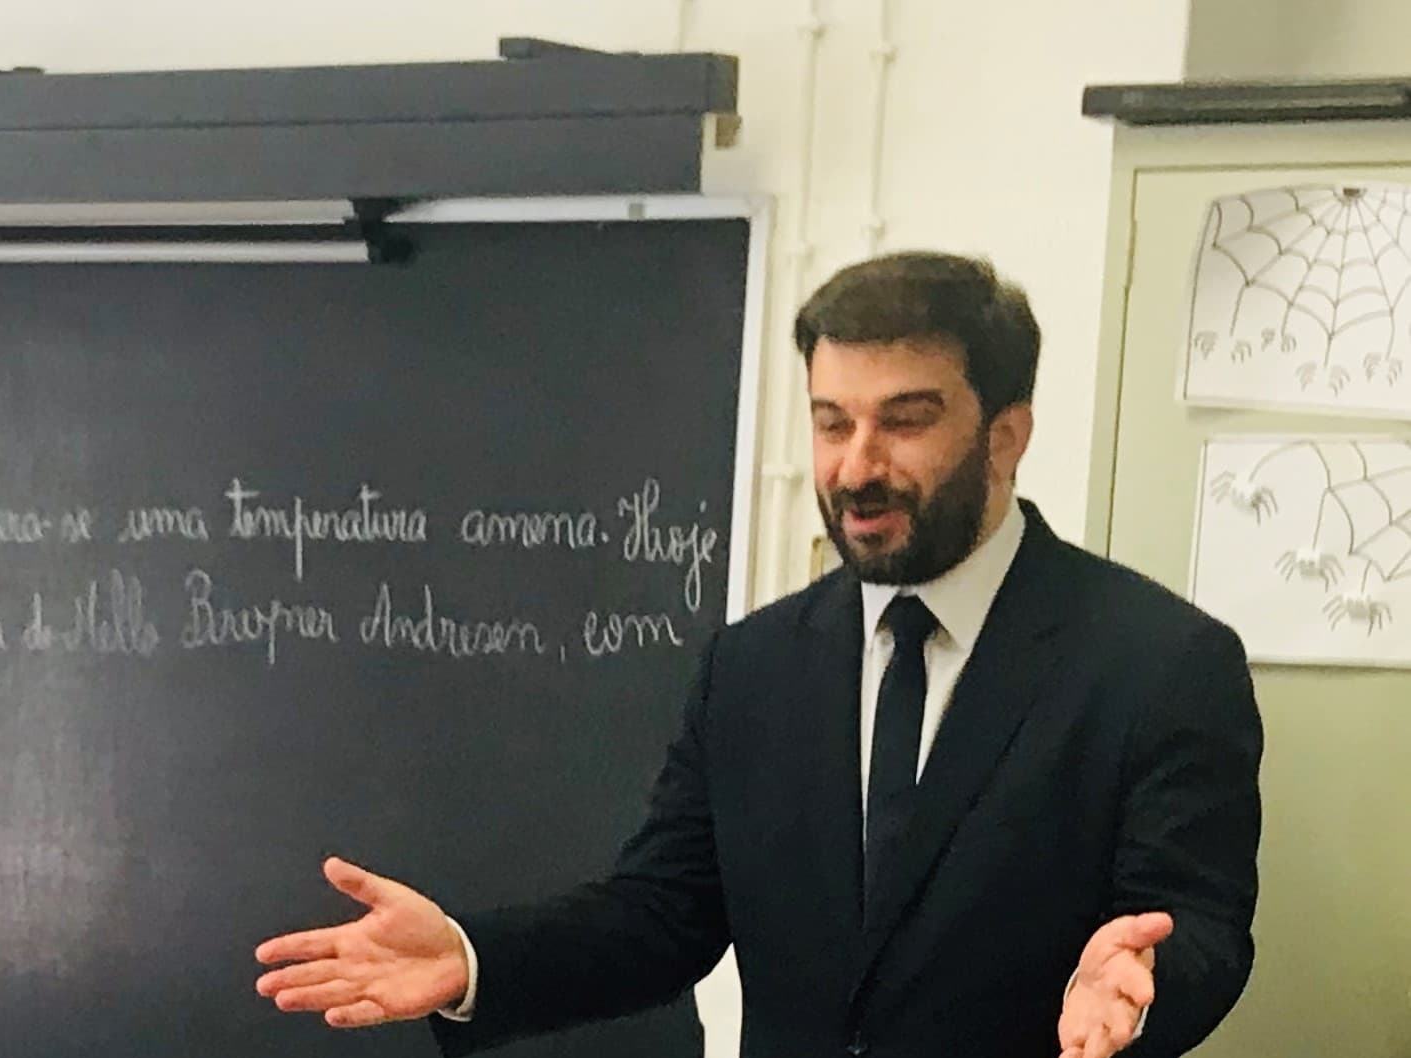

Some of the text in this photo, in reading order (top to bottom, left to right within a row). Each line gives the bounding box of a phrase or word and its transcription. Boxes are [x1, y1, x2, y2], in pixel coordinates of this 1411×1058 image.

[118, 505, 210, 544] uma
[223, 476, 428, 584] temperatura
[618, 478, 717, 613] Hoje
[583, 611, 684, 656] com
